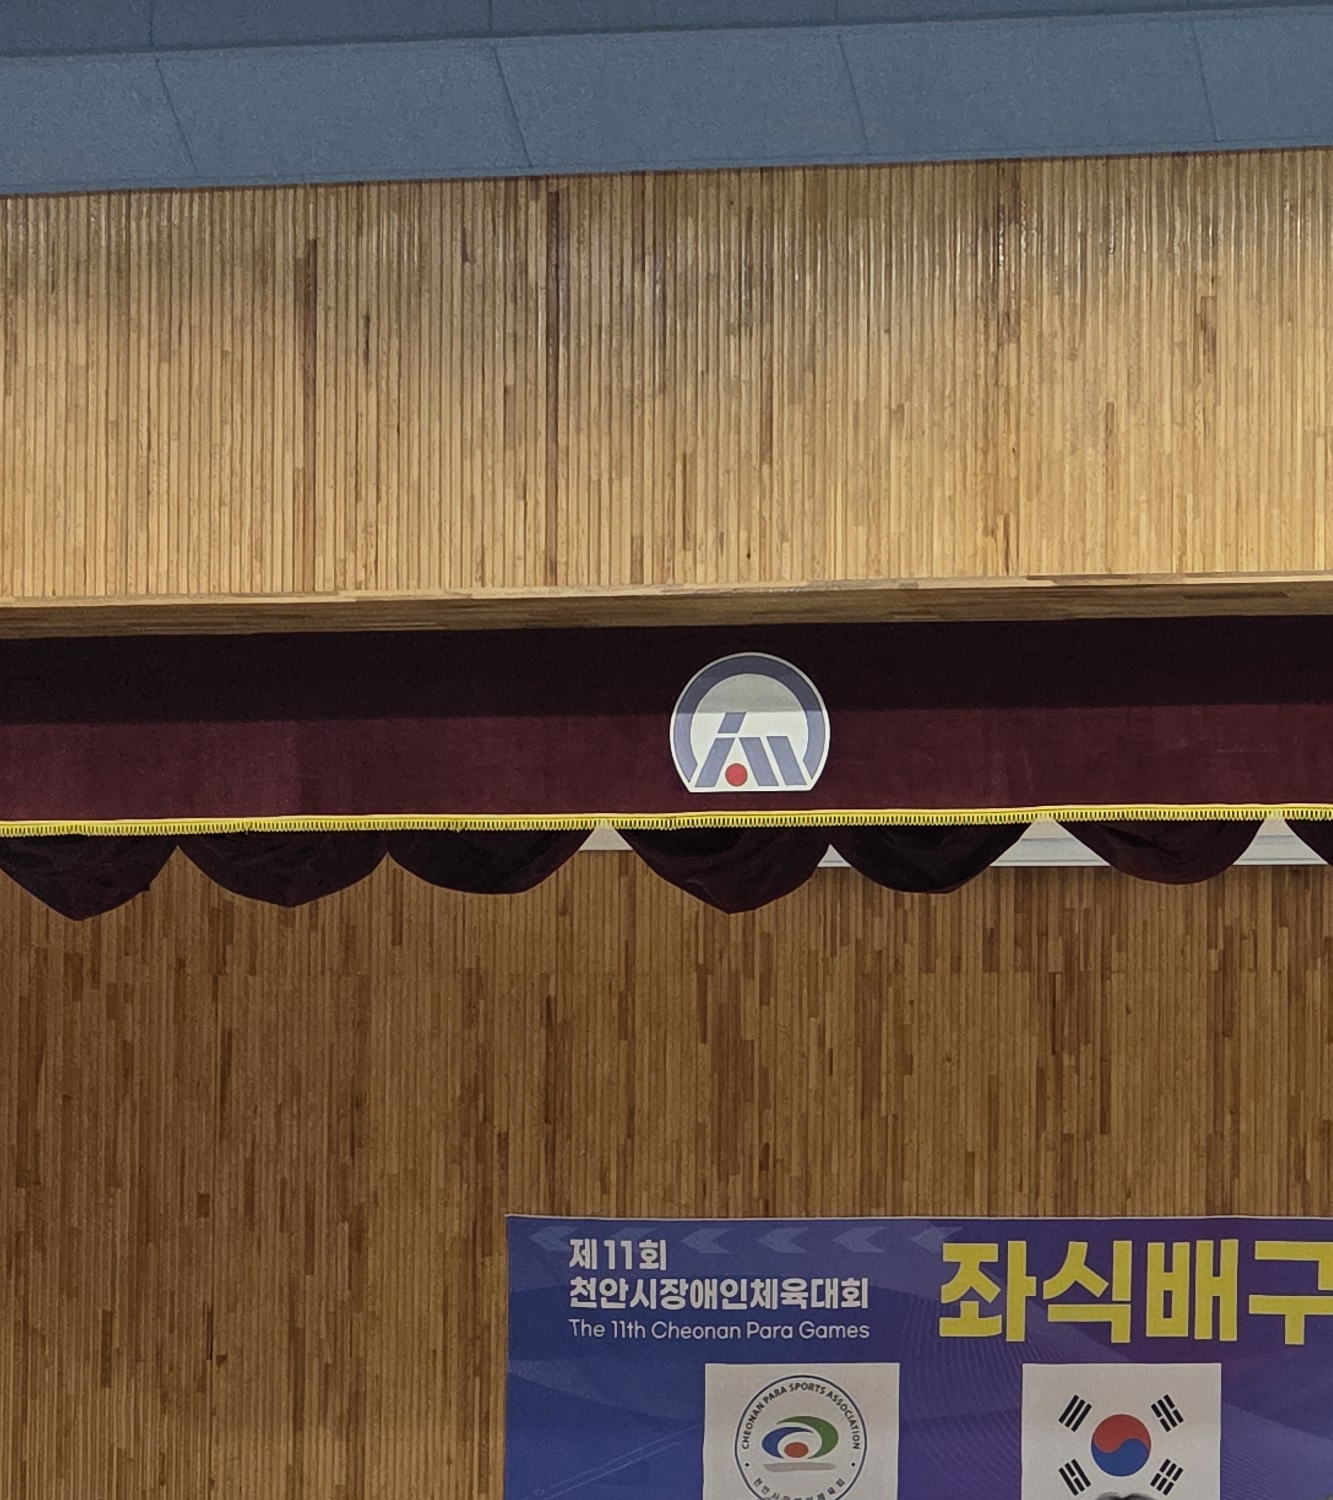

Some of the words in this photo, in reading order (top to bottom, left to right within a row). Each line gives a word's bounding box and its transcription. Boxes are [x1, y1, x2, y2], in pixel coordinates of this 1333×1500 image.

[568, 1238, 667, 1271] 제11회
[569, 1276, 870, 1310] 천안시장애인체육대회
[568, 1319, 606, 1338] The
[611, 1320, 647, 1339] 11th
[651, 1320, 742, 1340] Cheonan
[746, 1321, 794, 1339] Para
[798, 1320, 871, 1340] Games
[741, 1401, 766, 1451] CHEONAN
[763, 1385, 788, 1405] PARA
[789, 1382, 826, 1395] SPORTS
[825, 1390, 861, 1450] ASSOCIATION
